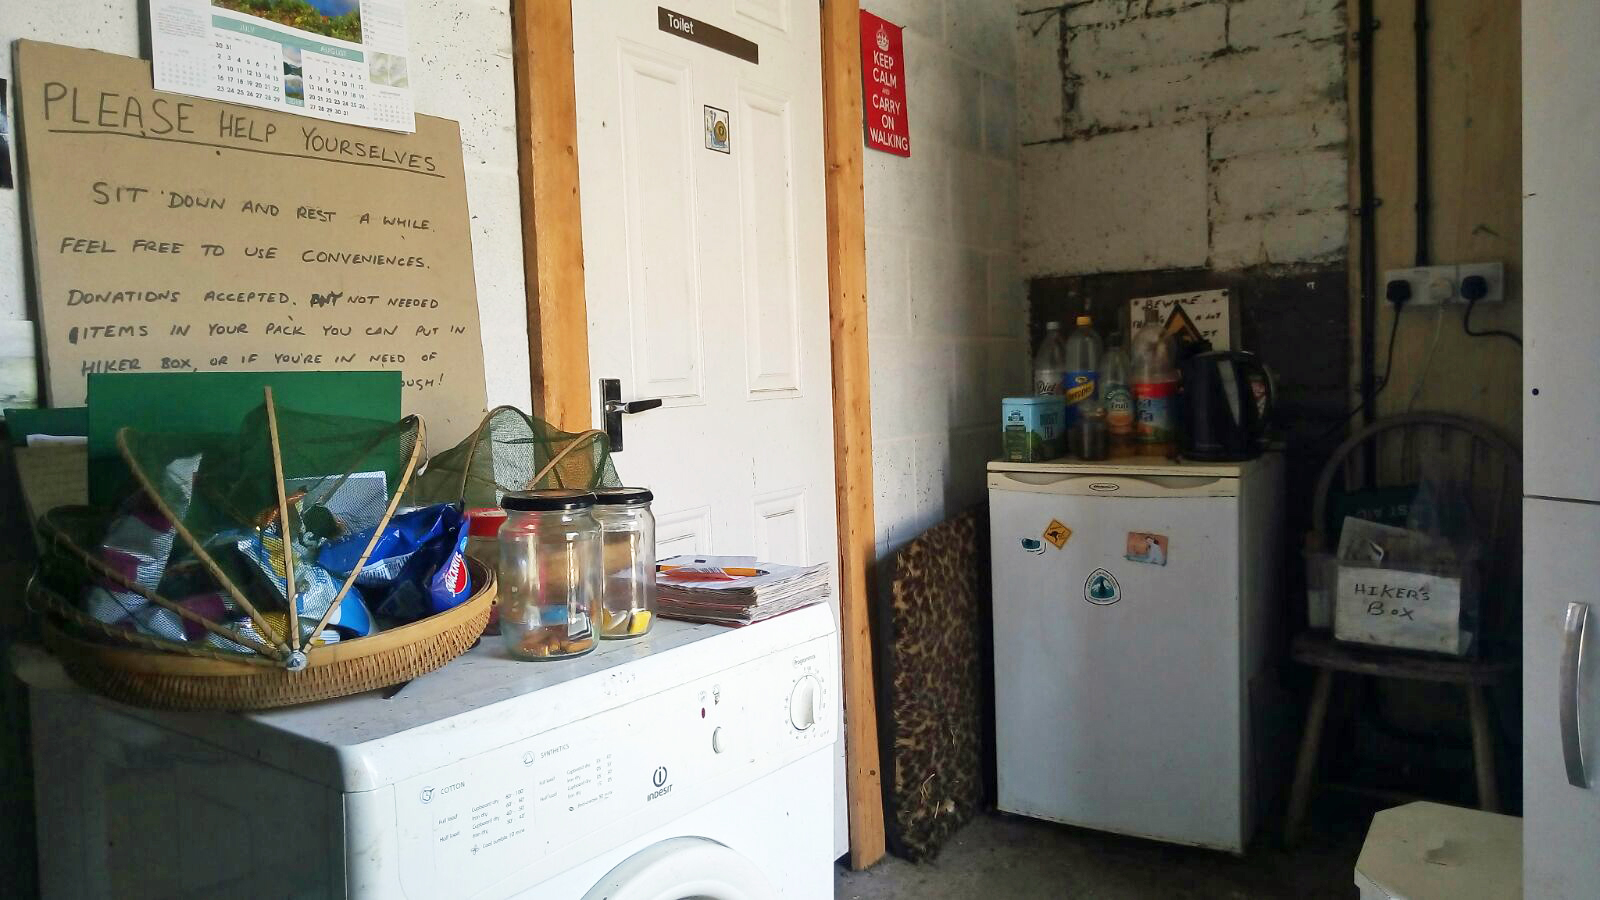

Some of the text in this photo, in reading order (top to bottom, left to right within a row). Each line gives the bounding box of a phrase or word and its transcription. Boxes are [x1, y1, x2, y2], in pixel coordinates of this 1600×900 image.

[240, 24, 255, 33] JULY
[667, 13, 694, 35] Toilet
[873, 50, 894, 70] KEEP
[872, 67, 897, 89] CALM
[872, 94, 901, 115] CARRY
[43, 82, 437, 173] PLEASE HELP YOURSELVES
[881, 114, 895, 131] ON
[869, 127, 908, 151] WALKING
[92, 182, 436, 234] SIT DOWN AND REST A WHILE.
[60, 237, 431, 270] FEEL FREE TO USE CONVENIENCES.
[67, 289, 179, 307] DONATIONS
[203, 291, 297, 306] ACCEPTED.
[347, 295, 379, 305] NOT
[387, 297, 439, 309] NEEDED
[82, 322, 466, 339] ITEMS IN YOUR PACK YOU CAN PUT IN
[81, 352, 438, 377] HIKER BOX, OR IF YOU'RE IN NEED OF
[1354, 583, 1431, 600] HIKER'S
[540, 743, 570, 759] SYNTHETICS
[440, 780, 465, 795] COTTON
